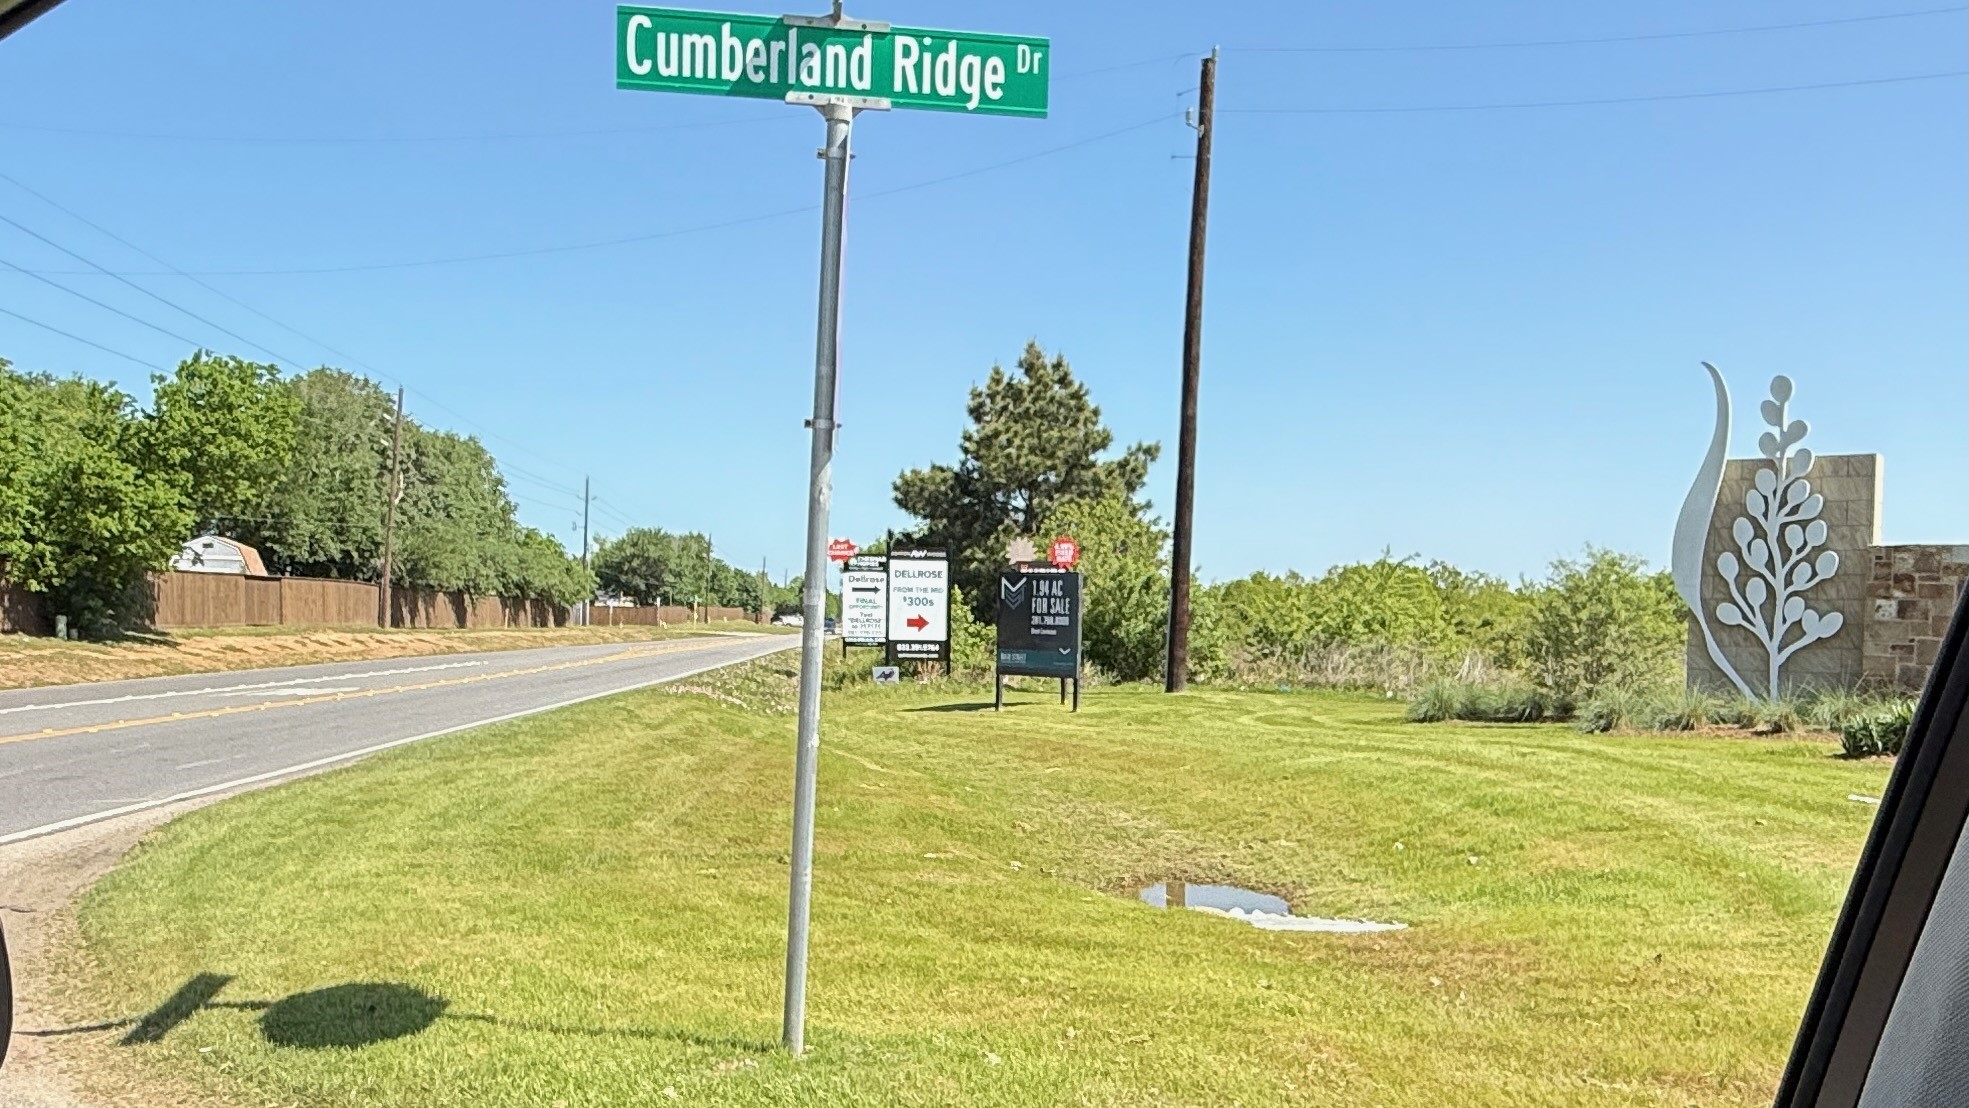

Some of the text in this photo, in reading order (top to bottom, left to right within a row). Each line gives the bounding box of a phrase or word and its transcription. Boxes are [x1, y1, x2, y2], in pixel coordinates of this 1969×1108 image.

[627, 14, 1042, 111] Cumberland Ridge Dr
[894, 569, 944, 579] DELLROSE
[915, 586, 929, 594] THE
[1032, 579, 1064, 597] 1.94 AC
[1031, 597, 1070, 615] FOR SALE
